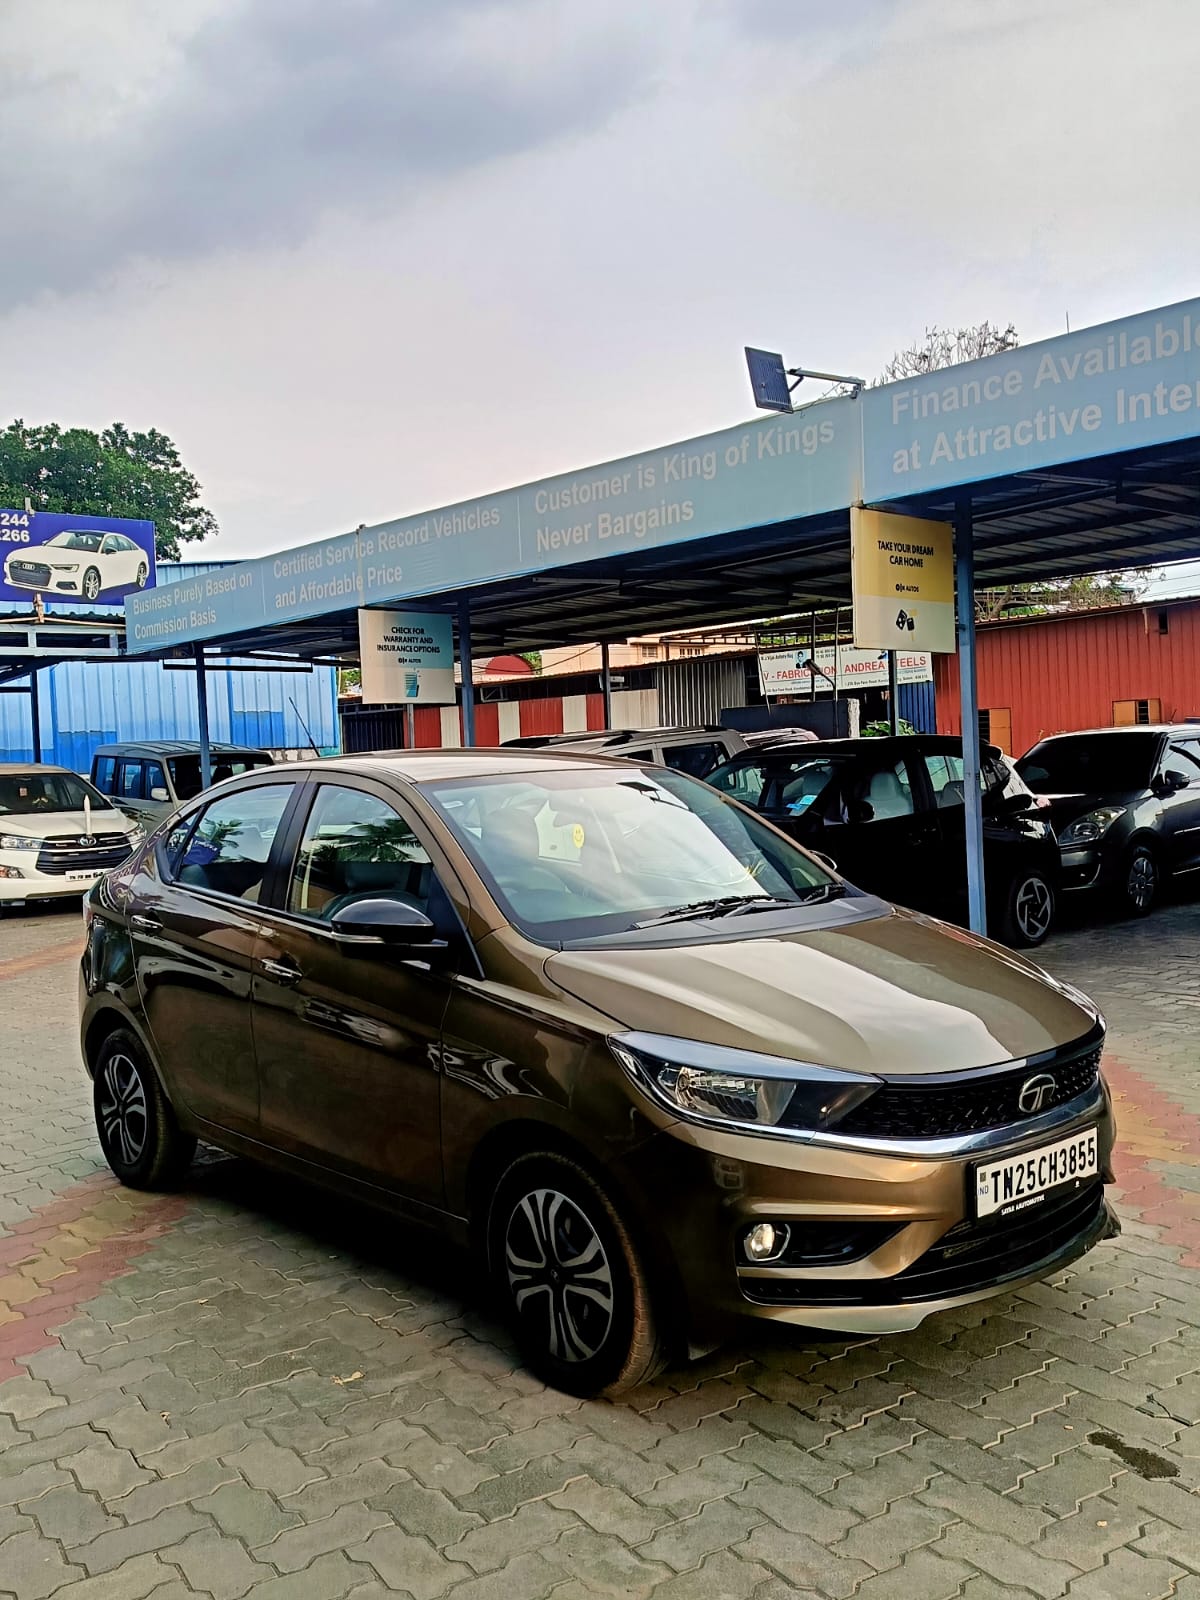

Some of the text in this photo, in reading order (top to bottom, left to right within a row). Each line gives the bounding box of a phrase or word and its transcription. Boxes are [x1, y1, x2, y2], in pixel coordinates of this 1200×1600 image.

[892, 314, 1200, 424] Finance Availabl
[892, 439, 921, 473] at
[930, 404, 1102, 465] Attractive
[535, 420, 834, 514] Customer is King of Kings
[0, 513, 30, 527] 244
[536, 499, 694, 552] Never Bargains
[273, 506, 501, 578] Certified Service Record Vehicles
[877, 540, 934, 556] TAKE YOUR DREAM
[889, 555, 924, 568] CAR HOME
[133, 571, 253, 615] Business Purely Based on
[275, 564, 402, 608] and Affordable Price
[134, 606, 217, 640] Commission Basis
[383, 635, 419, 643] WARRANTY
[391, 626, 411, 634] CHECK
[376, 644, 413, 653] INSURANCE
[763, 672, 769, 681] V
[844, 661, 885, 673] ANDREA
[991, 1137, 1095, 1203] TN25CH3855
